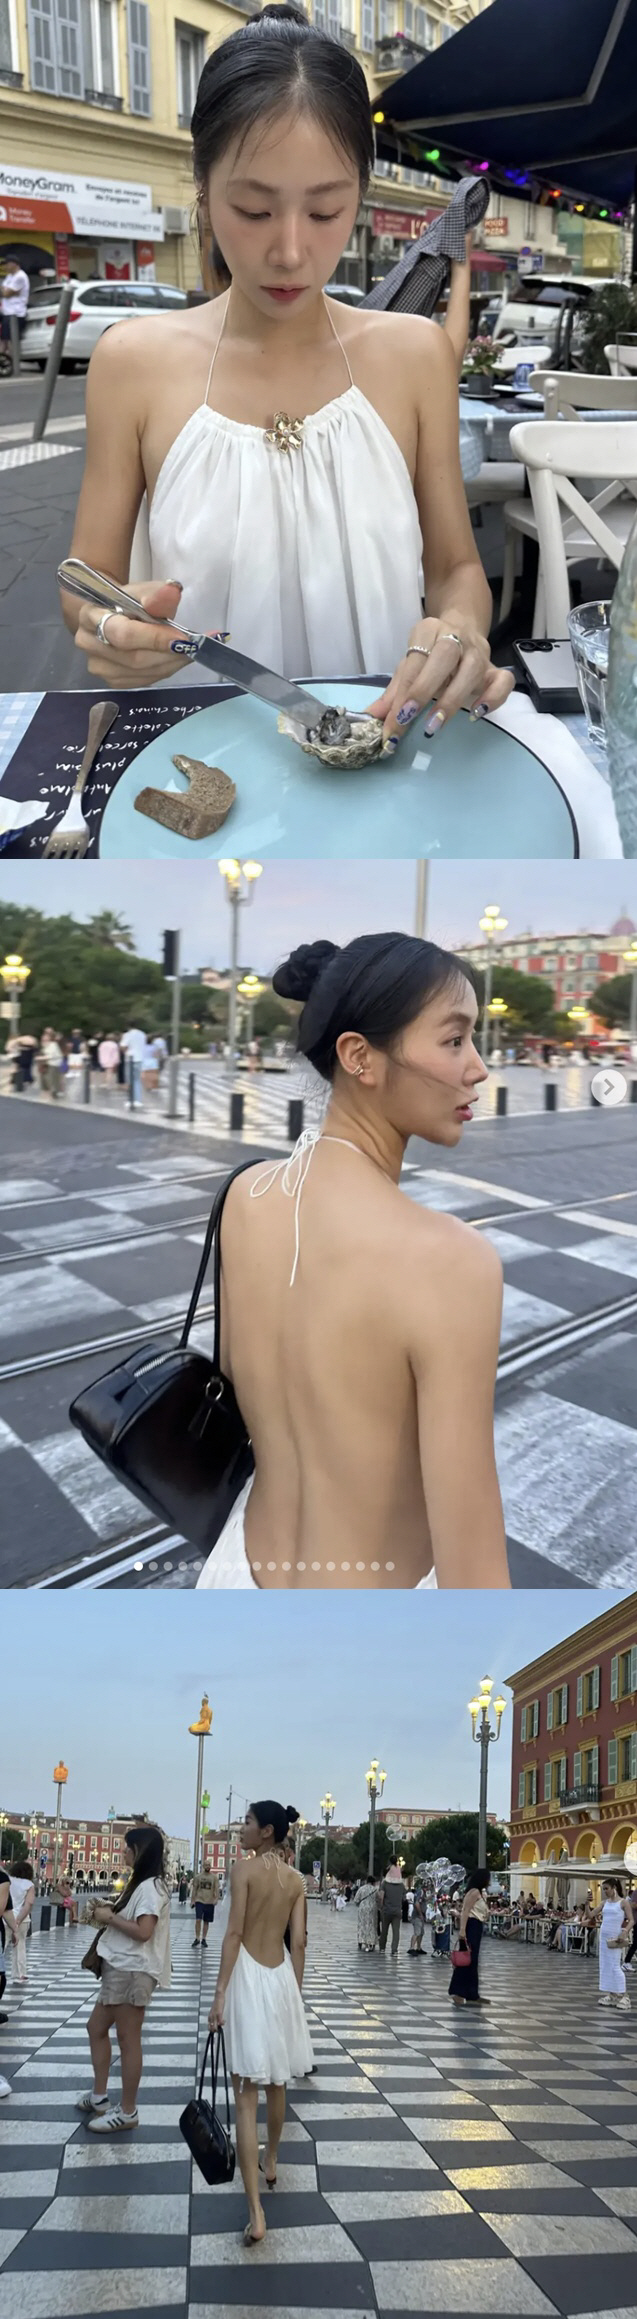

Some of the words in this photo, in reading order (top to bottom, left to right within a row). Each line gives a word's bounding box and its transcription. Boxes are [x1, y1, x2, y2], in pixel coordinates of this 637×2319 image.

[128, 707, 169, 716] chinois
[56, 763, 82, 773] aim
[95, 757, 126, 771] plus
